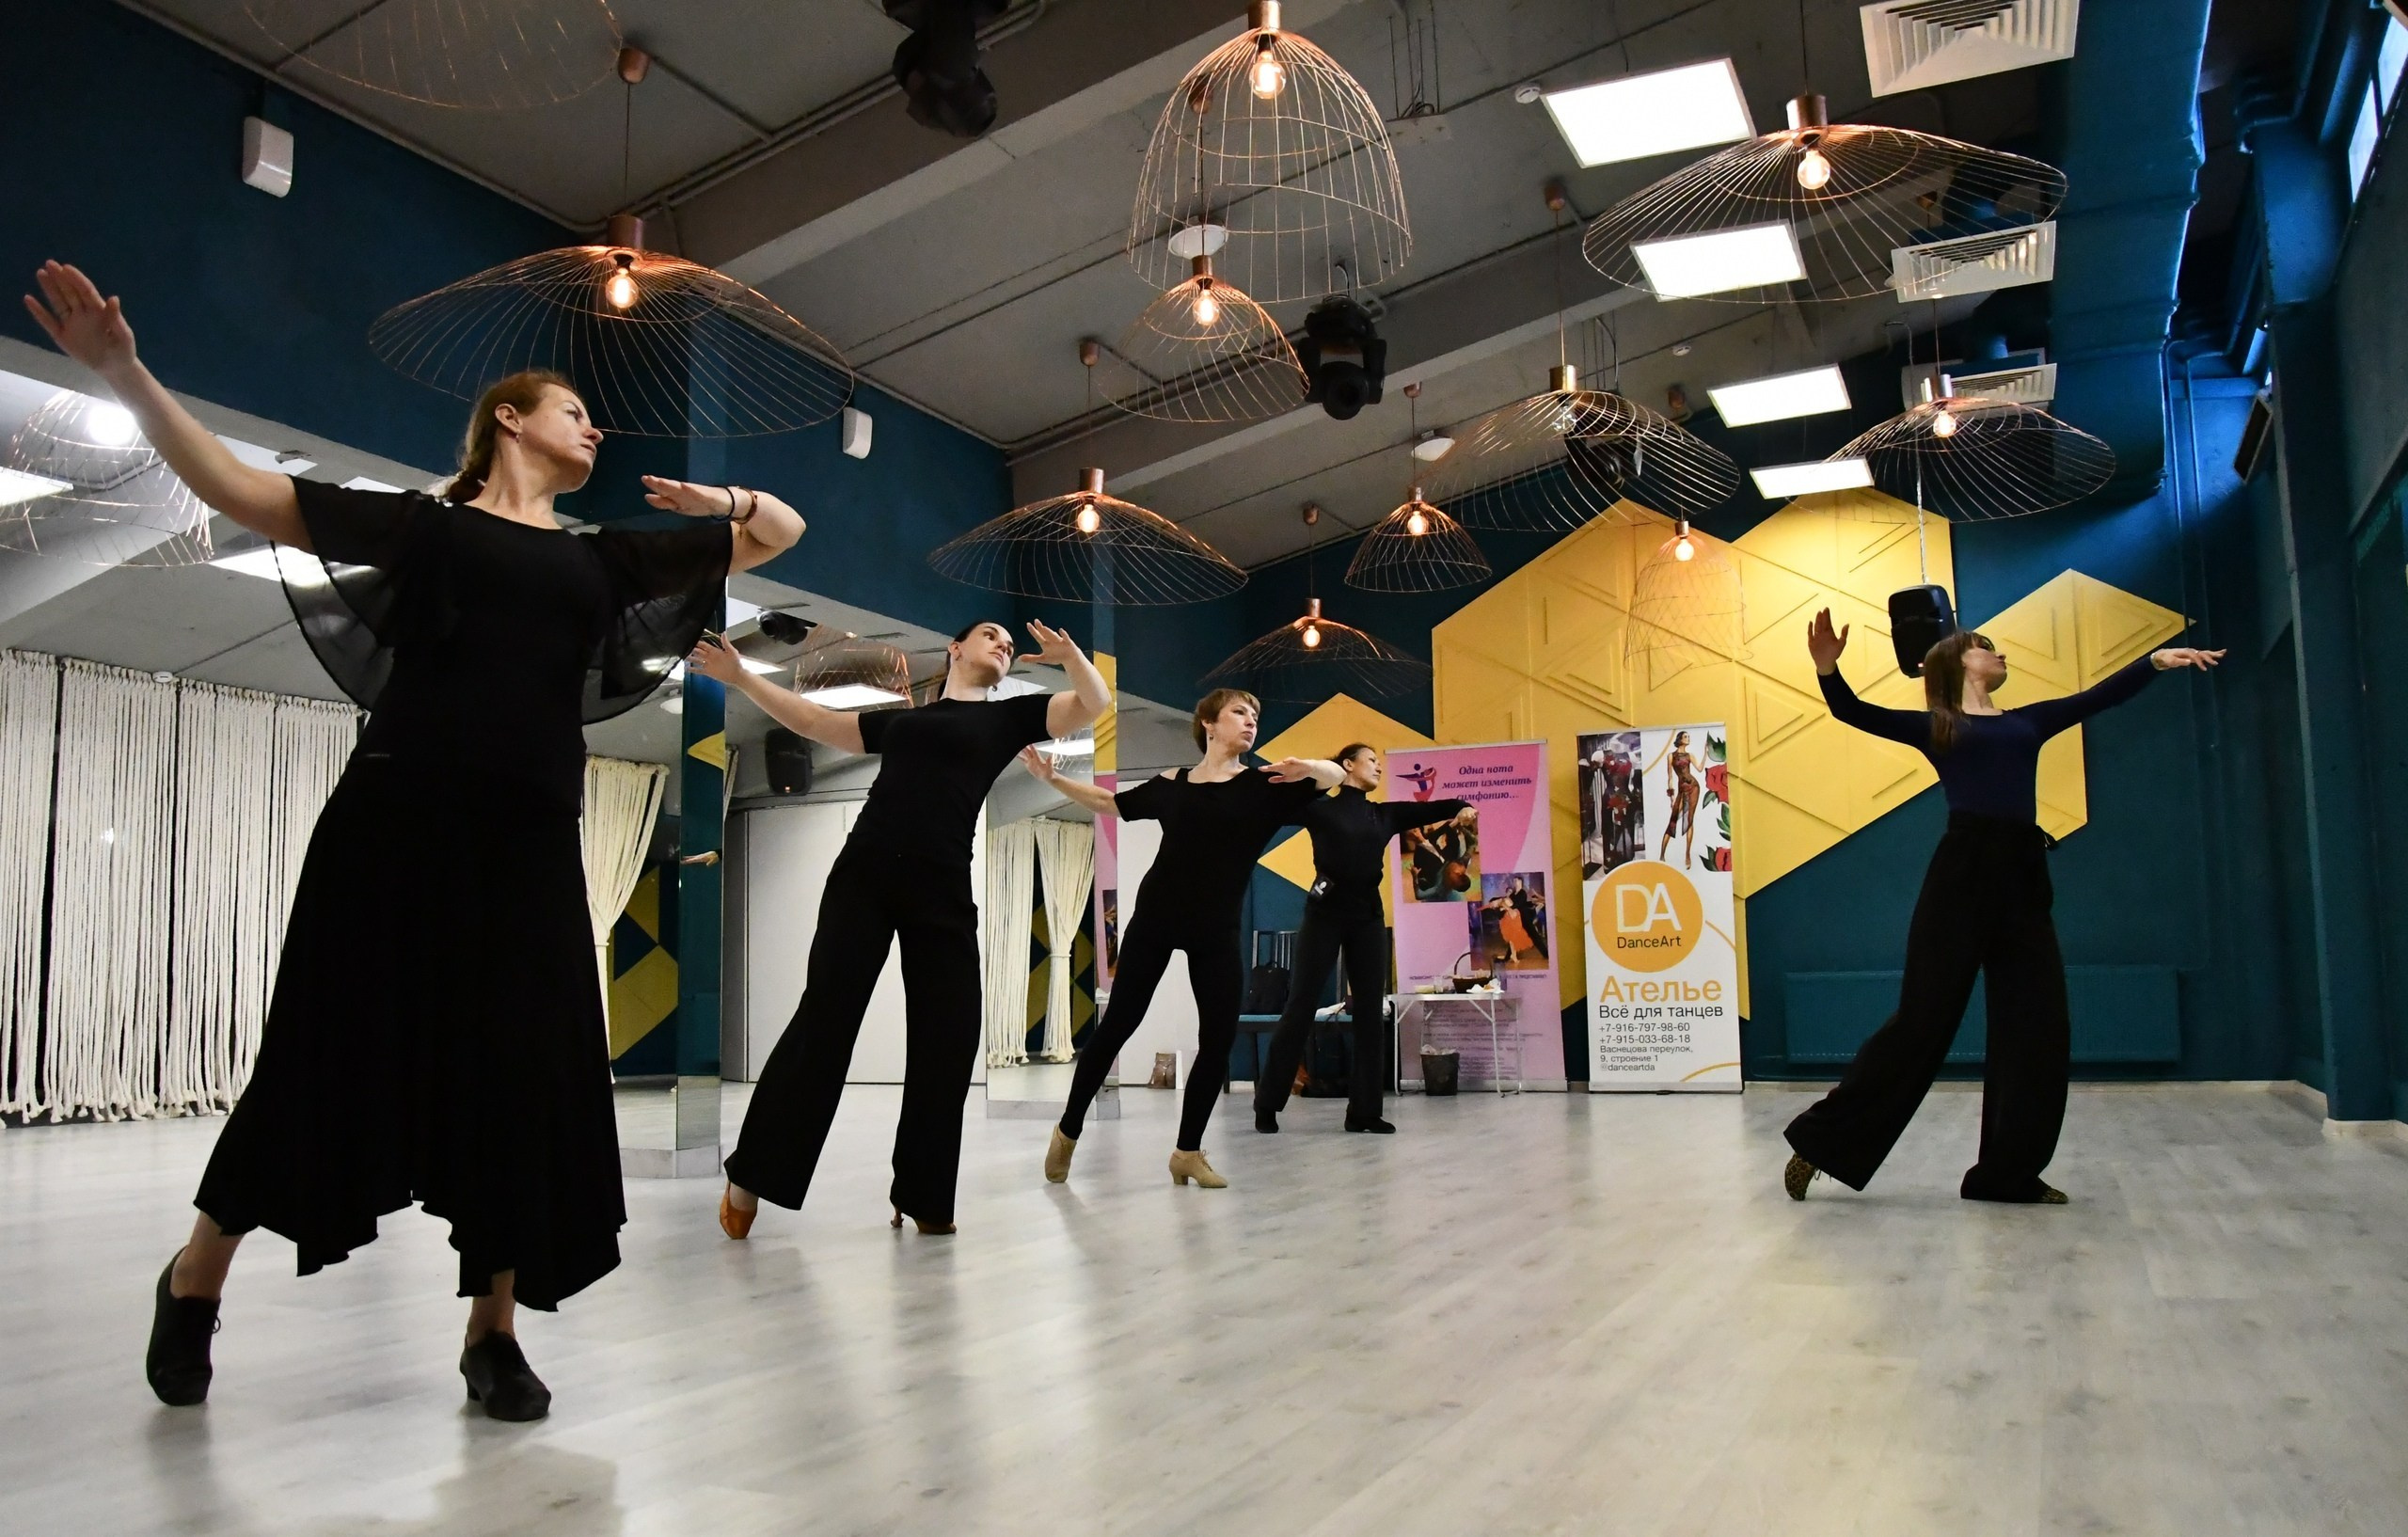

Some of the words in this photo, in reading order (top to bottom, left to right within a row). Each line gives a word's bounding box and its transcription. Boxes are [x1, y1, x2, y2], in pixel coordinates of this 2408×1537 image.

[1459, 765, 1484, 775] Одна
[1486, 765, 1513, 774] нота
[1442, 780, 1479, 789] может
[1481, 777, 1532, 787] изменить
[1615, 882, 1683, 933] DA
[1617, 935, 1682, 949] DanceArt
[1599, 975, 1722, 1004] Ателье
[1599, 1005, 1629, 1019] Всё
[1634, 1006, 1662, 1021] для
[1667, 1006, 1723, 1020] танцев
[1599, 1022, 1690, 1033] +7-916-797-98-60
[1599, 1034, 1691, 1044] +7-915-033-68-18
[1600, 1045, 1647, 1054] Васнецова
